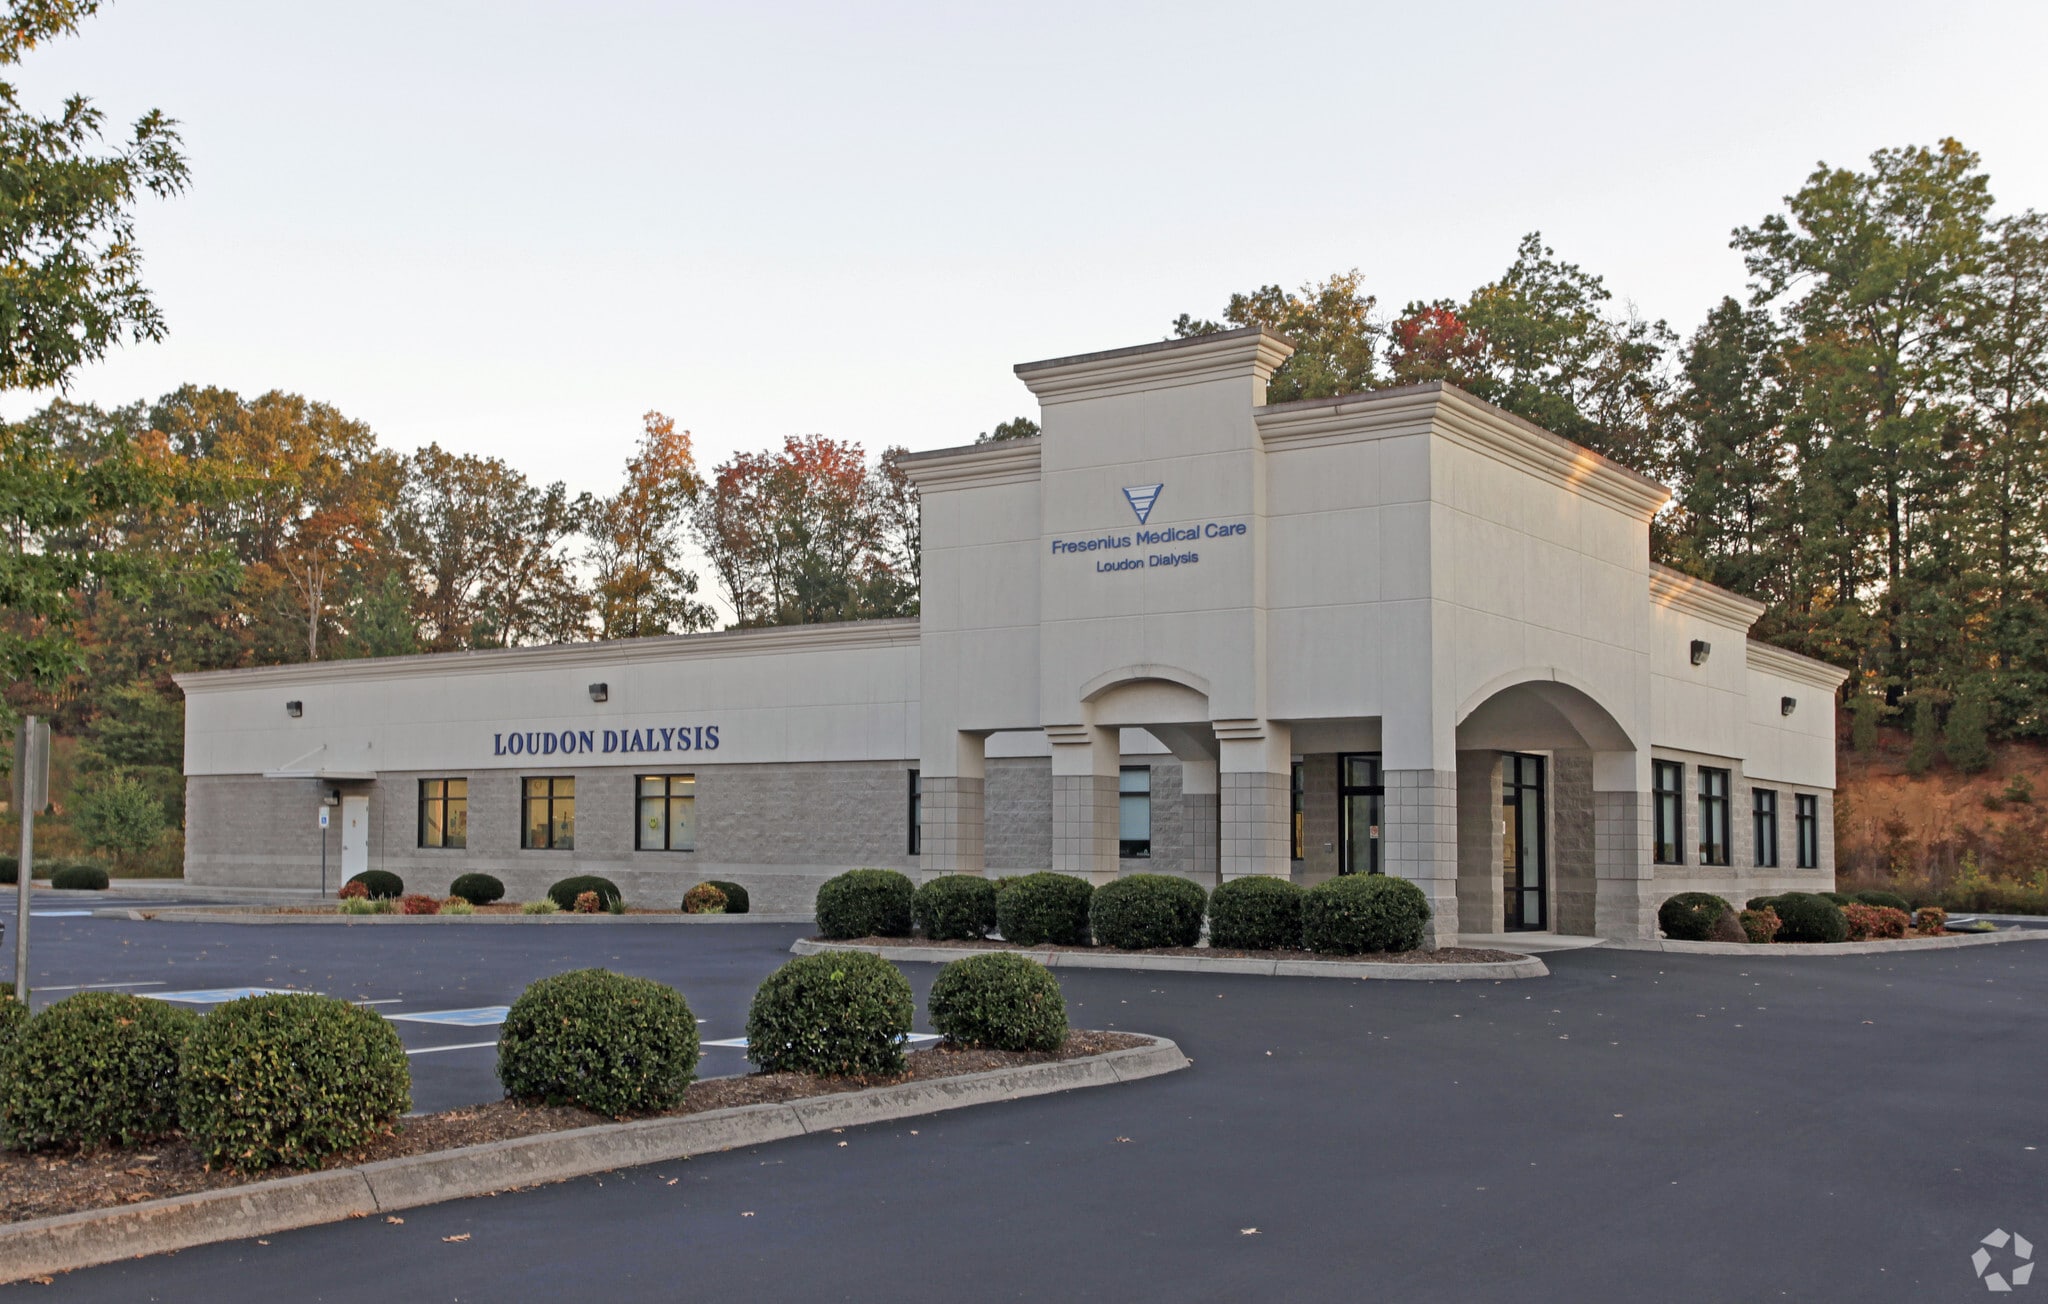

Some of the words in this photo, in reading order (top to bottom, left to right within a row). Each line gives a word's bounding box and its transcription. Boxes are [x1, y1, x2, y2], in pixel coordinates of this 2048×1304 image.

[1052, 535, 1131, 554] Fresenius
[1136, 525, 1200, 546] Medical
[1205, 523, 1247, 538] Care
[1097, 558, 1144, 573] Loudon
[1149, 551, 1199, 567] Dialysis
[494, 730, 594, 756] LOUDON
[602, 725, 720, 753] DIALYSIS
